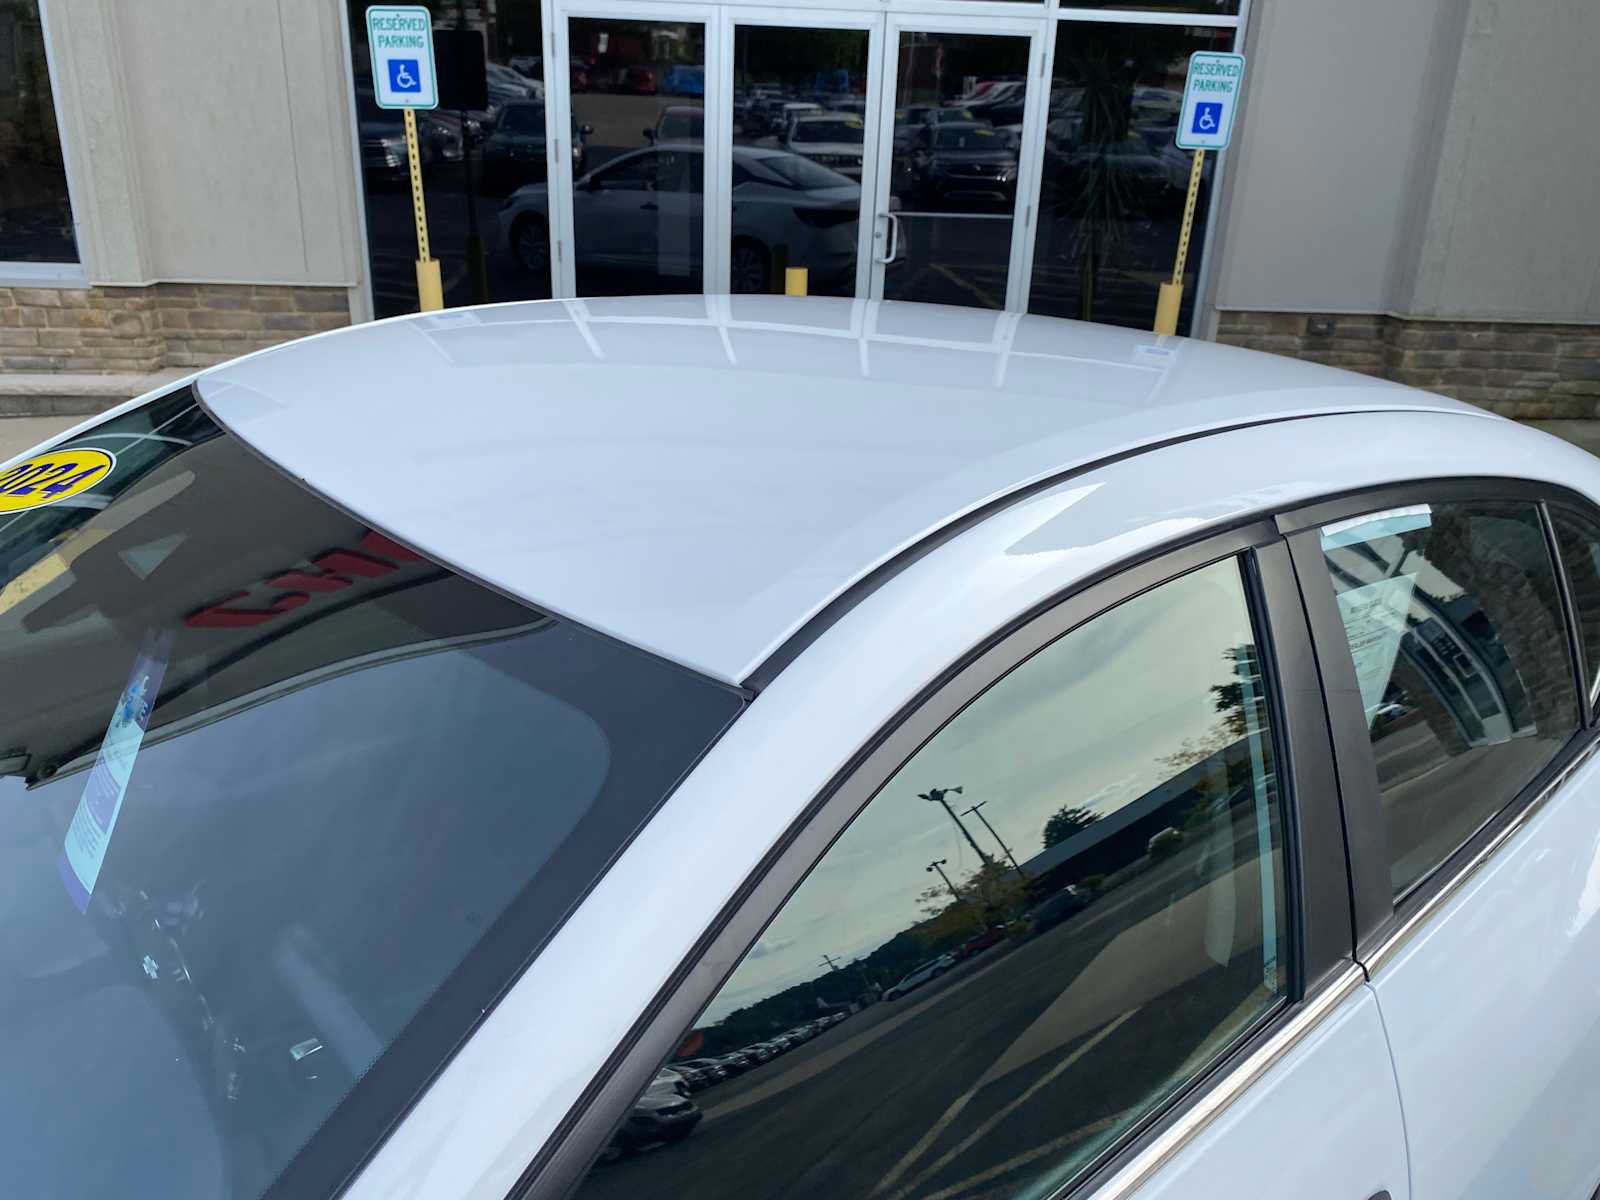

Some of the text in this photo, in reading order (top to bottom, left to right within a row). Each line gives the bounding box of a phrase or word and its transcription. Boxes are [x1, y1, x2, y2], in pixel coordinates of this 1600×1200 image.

[372, 17, 426, 31] RESERVED
[378, 35, 425, 48] PARKING
[1191, 63, 1240, 77] RESERVED
[1193, 79, 1234, 93] PARKING
